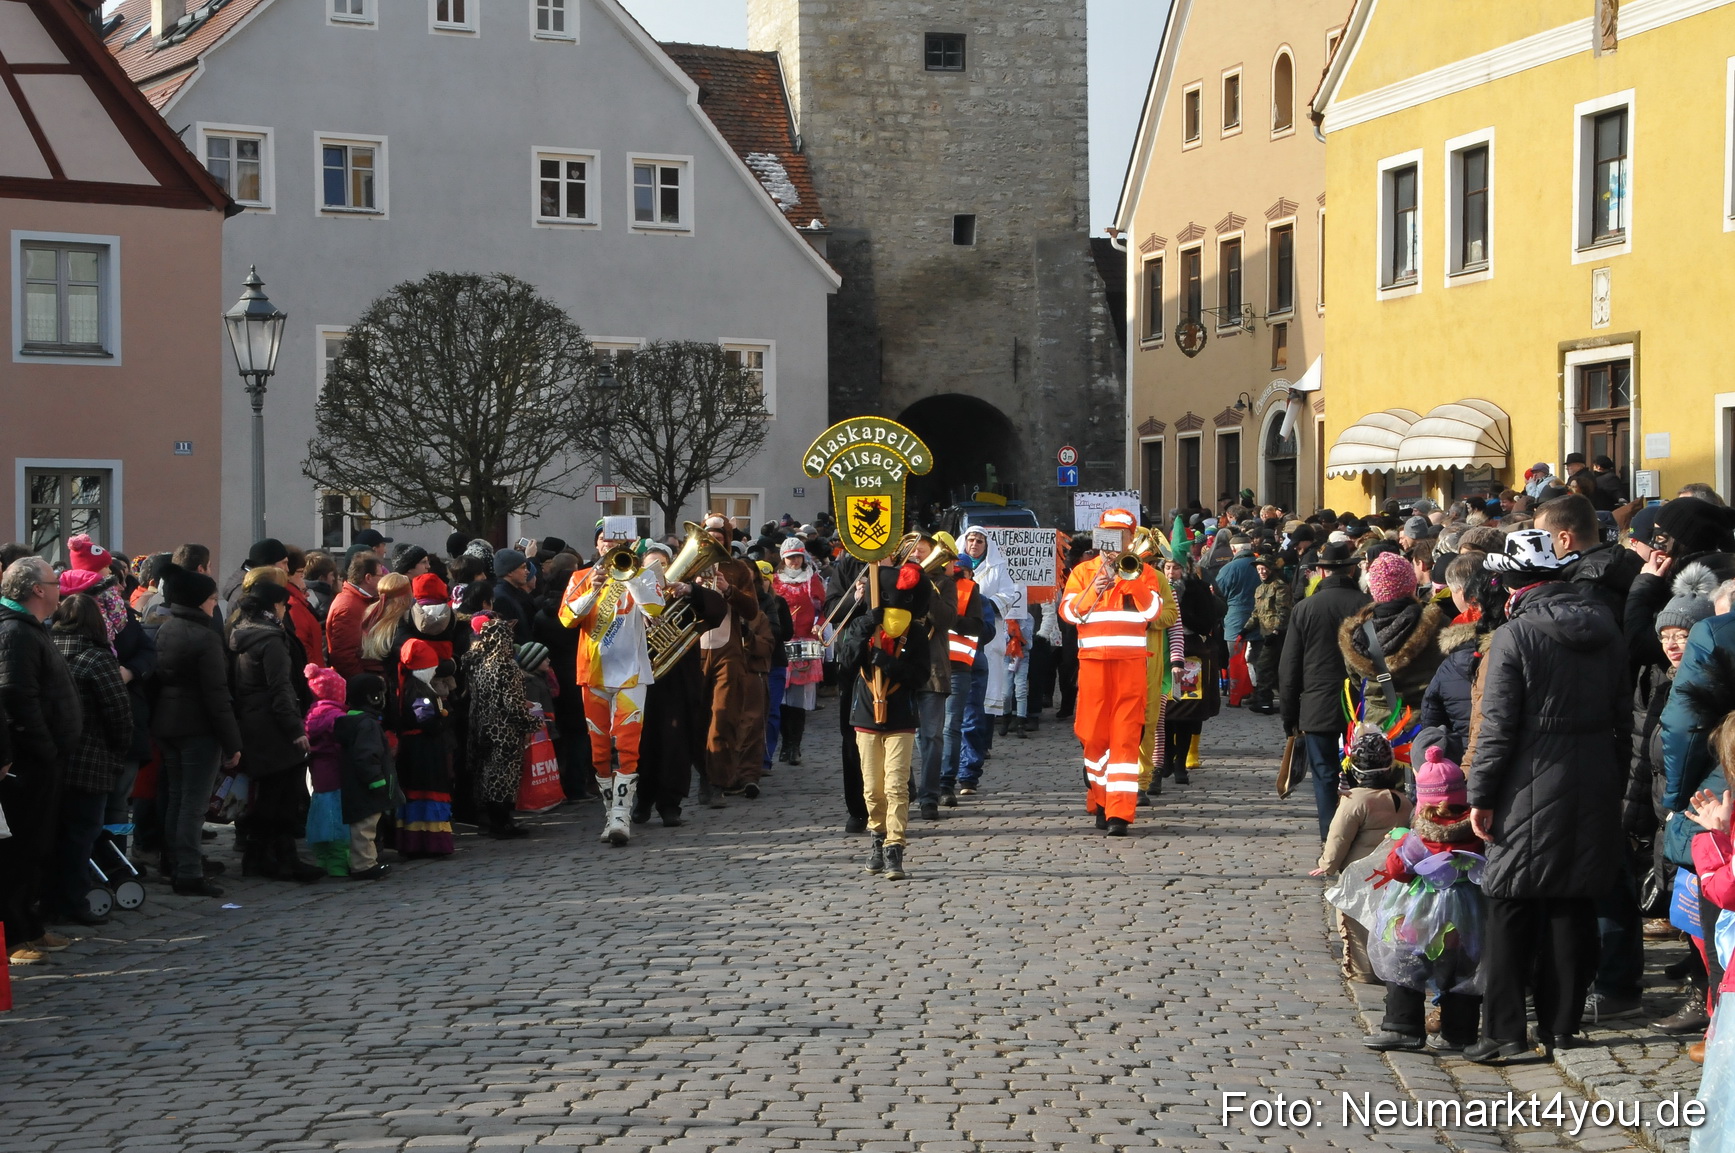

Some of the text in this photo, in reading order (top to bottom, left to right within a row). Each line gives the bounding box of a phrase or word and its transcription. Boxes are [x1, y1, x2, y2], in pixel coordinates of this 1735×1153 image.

[180, 442, 188, 450] 11
[806, 425, 923, 473] Blaskapelle
[830, 451, 903, 481] Pilsach
[854, 476, 882, 488] 1954
[1005, 547, 1053, 557] BRAUCHEN
[1008, 557, 1040, 566] KEINEN
[1007, 568, 1052, 583] RSCHLAF
[1011, 591, 1022, 608] 2
[605, 620, 616, 636] RADIO
[531, 758, 558, 777] REW
[532, 777, 548, 786] esser
